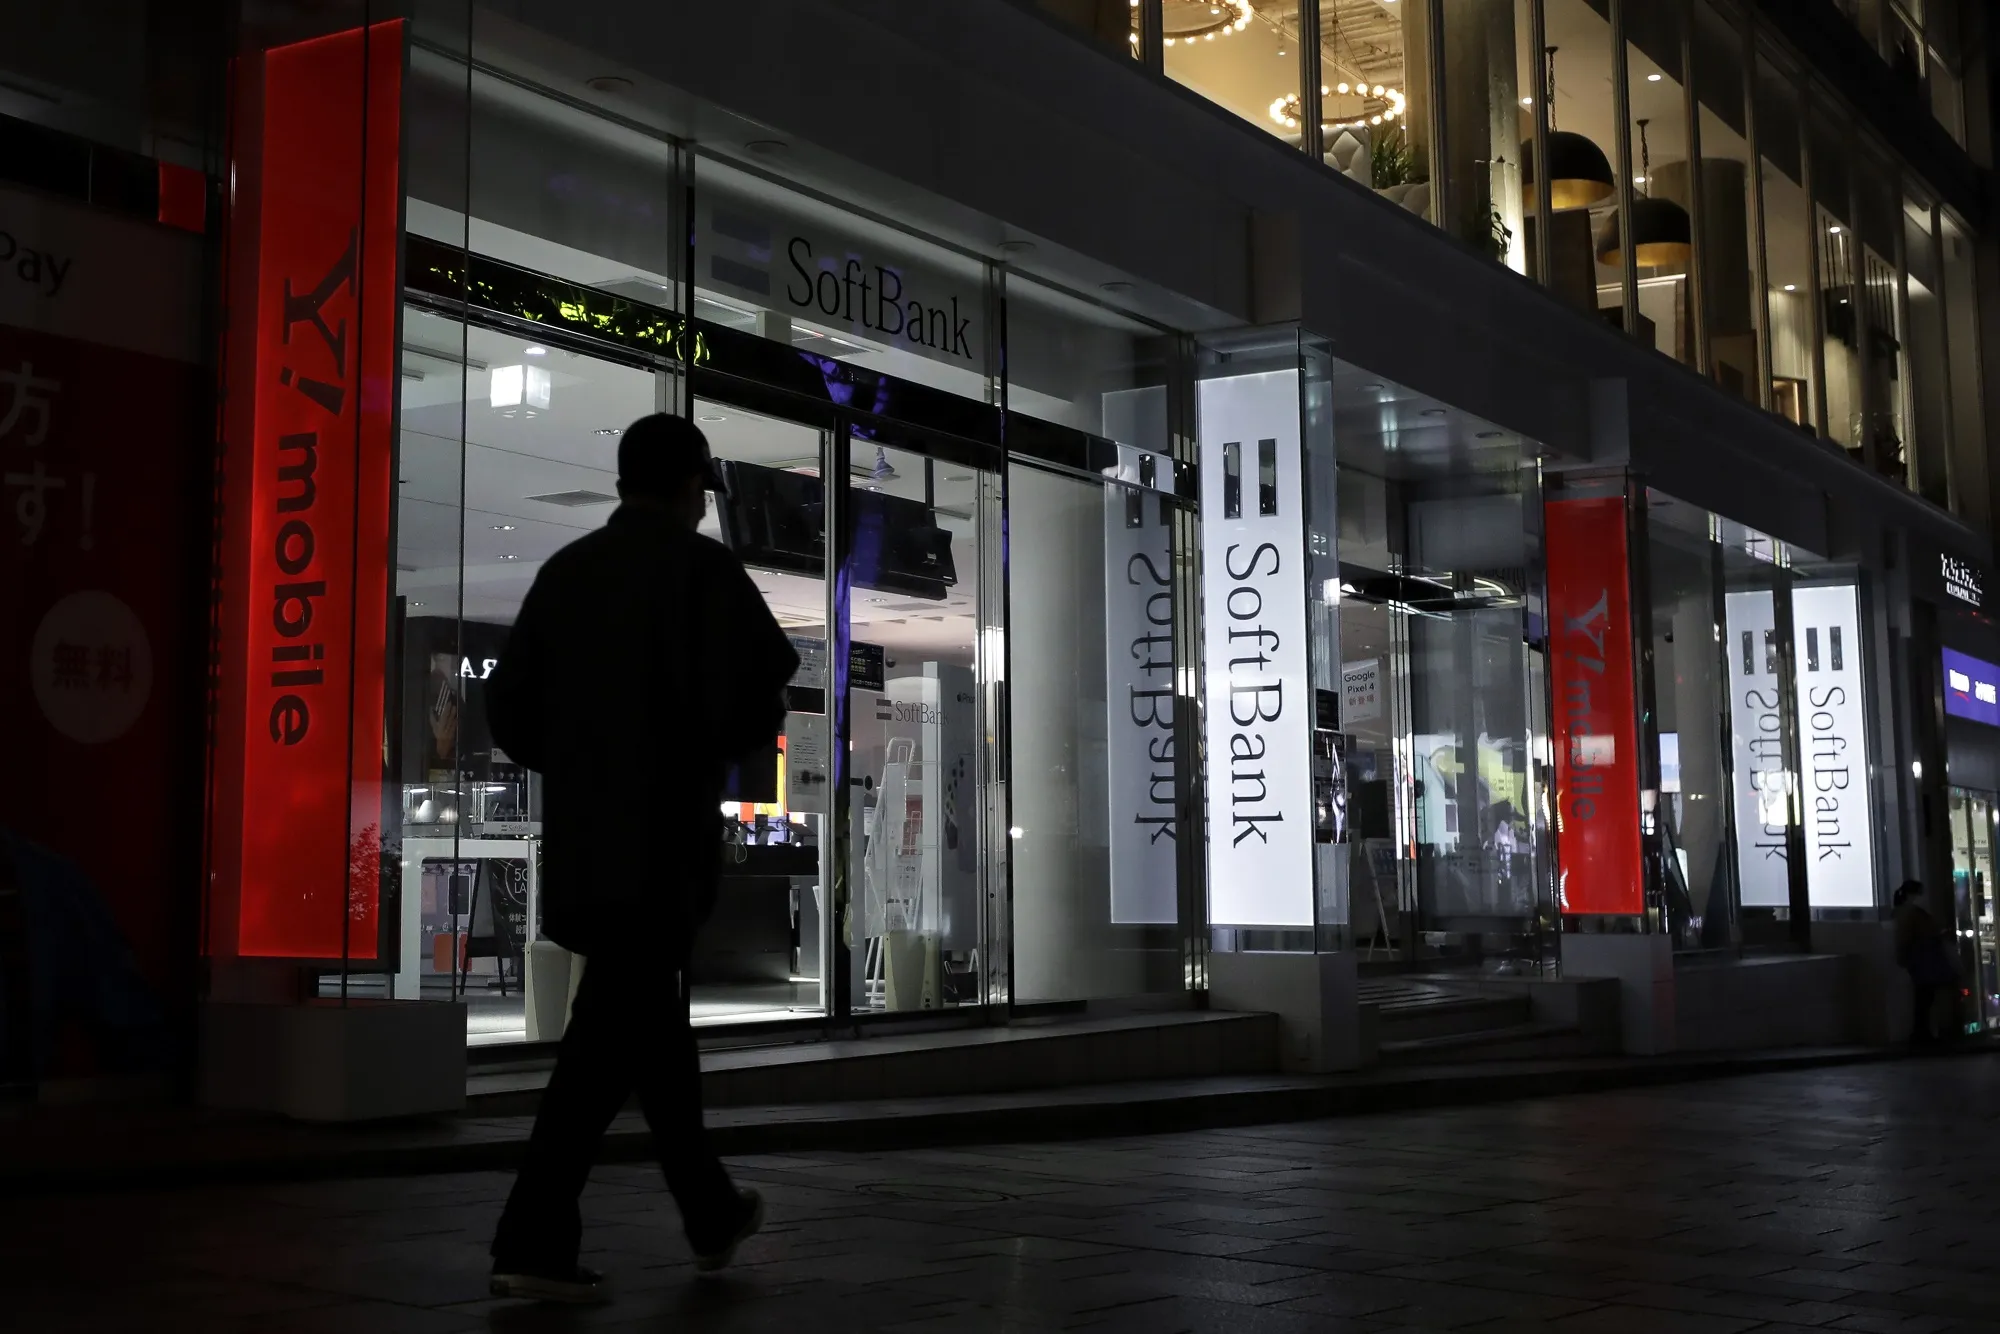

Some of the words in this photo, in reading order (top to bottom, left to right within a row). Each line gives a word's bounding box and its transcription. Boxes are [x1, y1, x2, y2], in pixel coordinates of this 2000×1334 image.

[786, 236, 973, 359] SoftBank
[51, 641, 134, 695] 無料
[1344, 671, 1375, 682] Google
[1347, 683, 1367, 693] Pixel
[1369, 682, 1375, 690] 4
[895, 700, 949, 727] SoftBank
[1225, 542, 1284, 849] SoftBank
[1809, 686, 1852, 862] SoftBank
